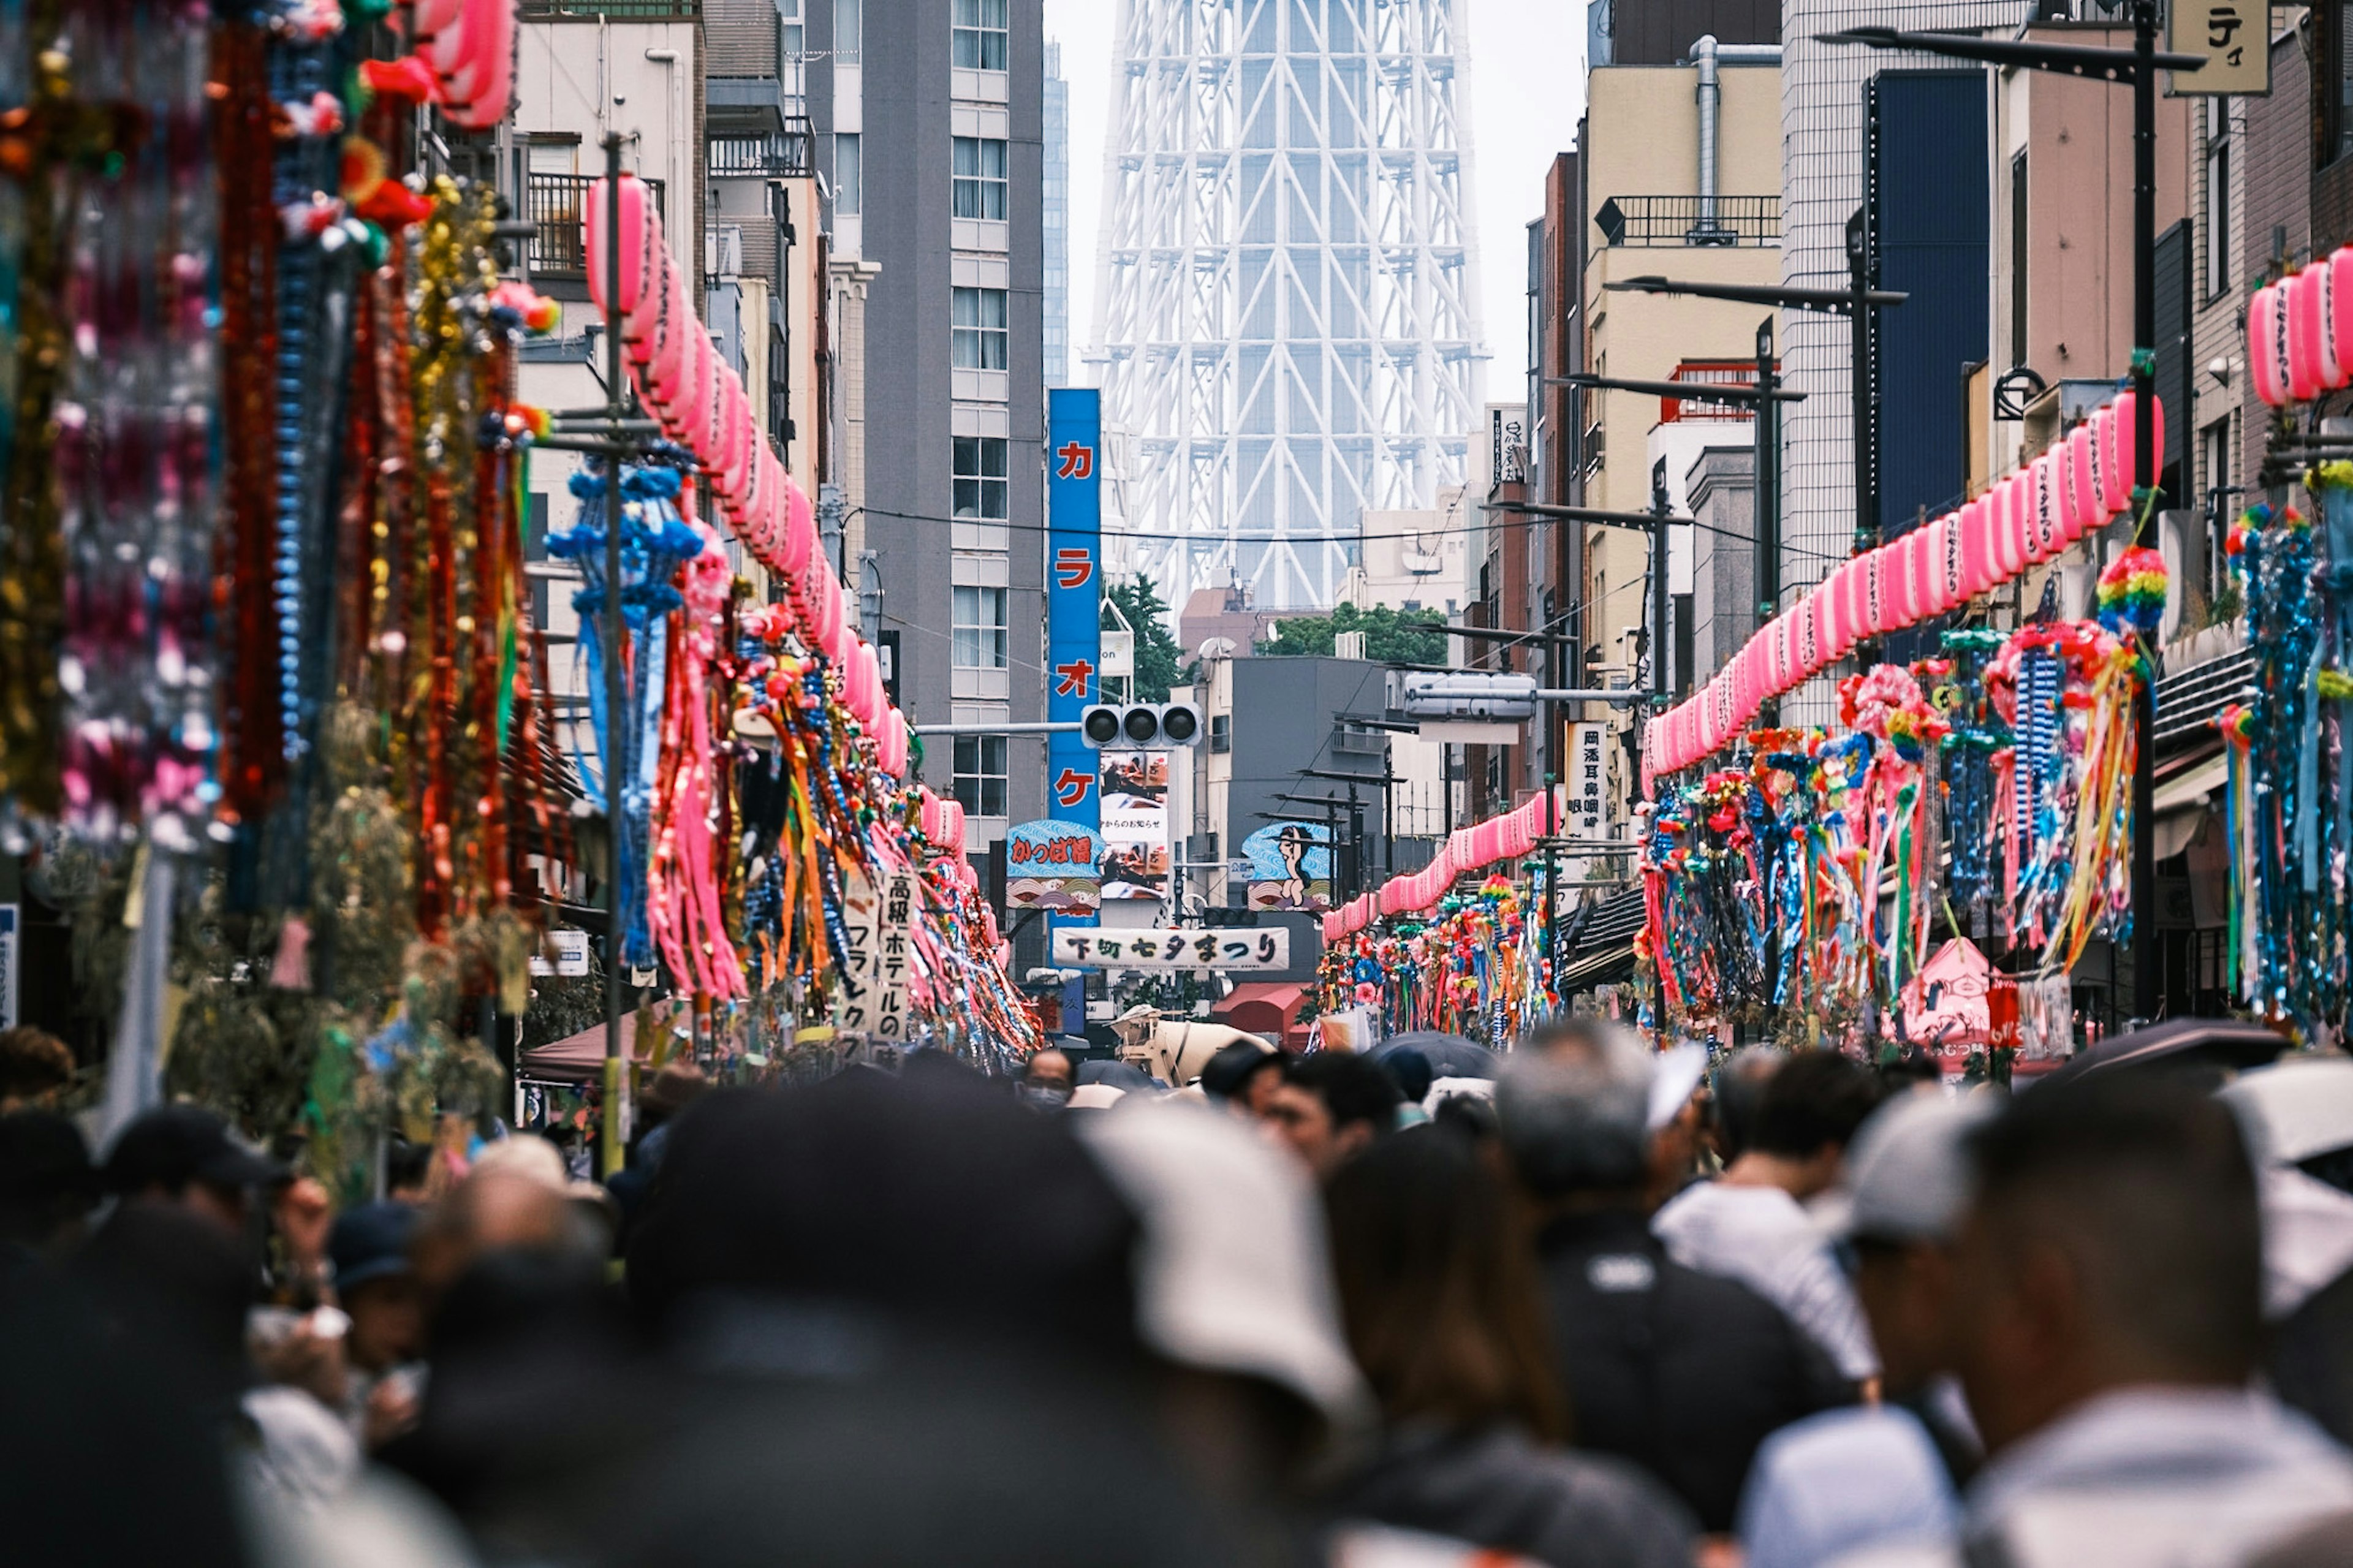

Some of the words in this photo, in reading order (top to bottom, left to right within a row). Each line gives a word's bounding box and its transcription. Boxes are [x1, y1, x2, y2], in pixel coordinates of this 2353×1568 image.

[1101, 820, 1160, 828] からのお知らせ
[1067, 933, 1277, 963] 下町七夕まつり
